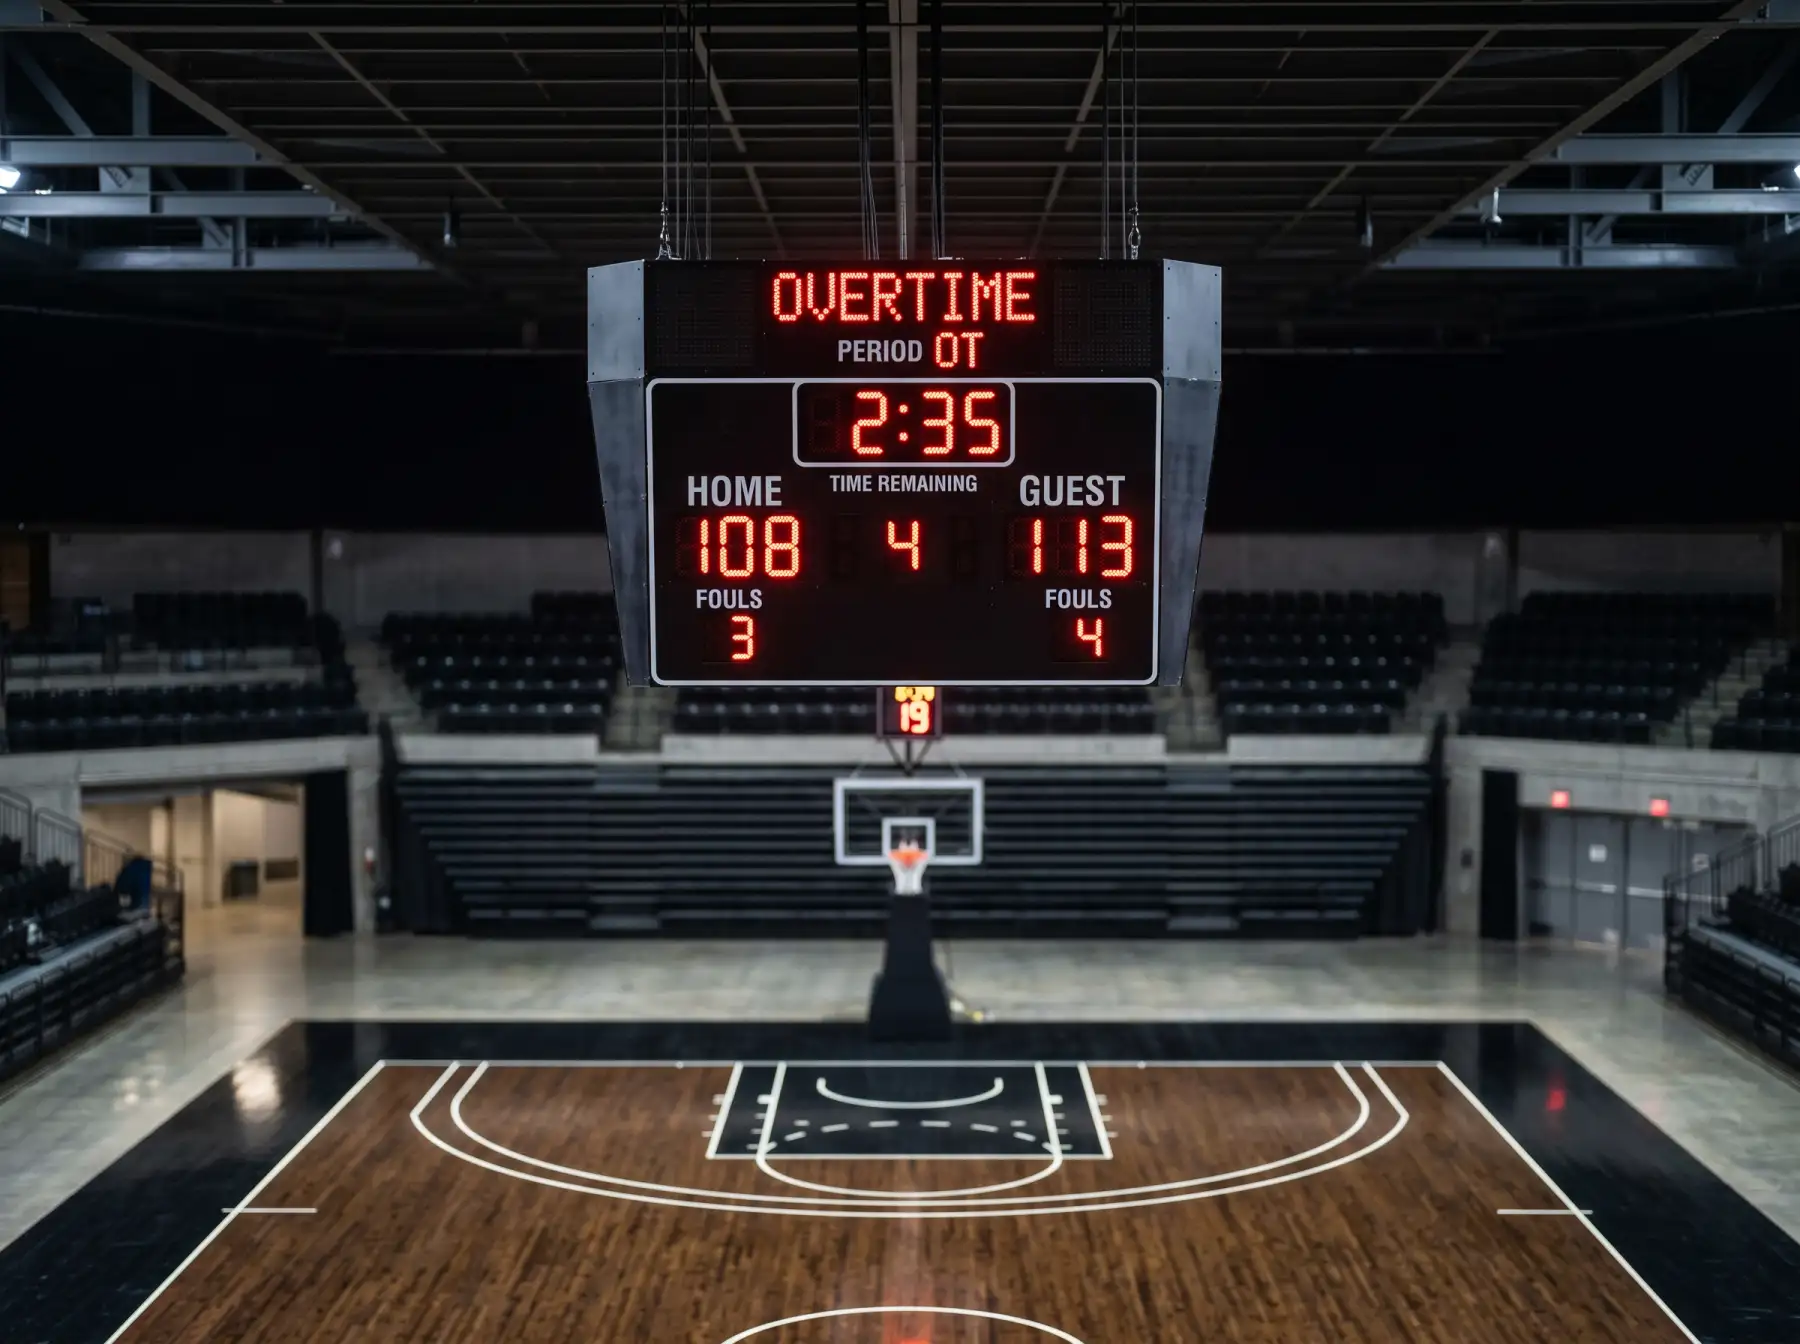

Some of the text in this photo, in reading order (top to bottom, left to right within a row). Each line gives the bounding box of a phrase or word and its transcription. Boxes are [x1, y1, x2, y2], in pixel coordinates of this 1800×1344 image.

[772, 271, 1036, 322] OVERTIME
[839, 332, 984, 368] PERIOD OT
[851, 390, 1000, 456] 2:35
[689, 476, 781, 506] HOME
[830, 475, 976, 491] TIME REMAINING
[1020, 475, 1125, 506] GUEST
[700, 514, 801, 580] 108
[888, 520, 920, 570] 4
[1032, 514, 1134, 579] 113
[697, 589, 762, 608] FOULS
[1046, 589, 1111, 608] FOULS
[732, 614, 755, 661] 3
[1076, 618, 1104, 657] 4
[900, 701, 930, 734] 19
